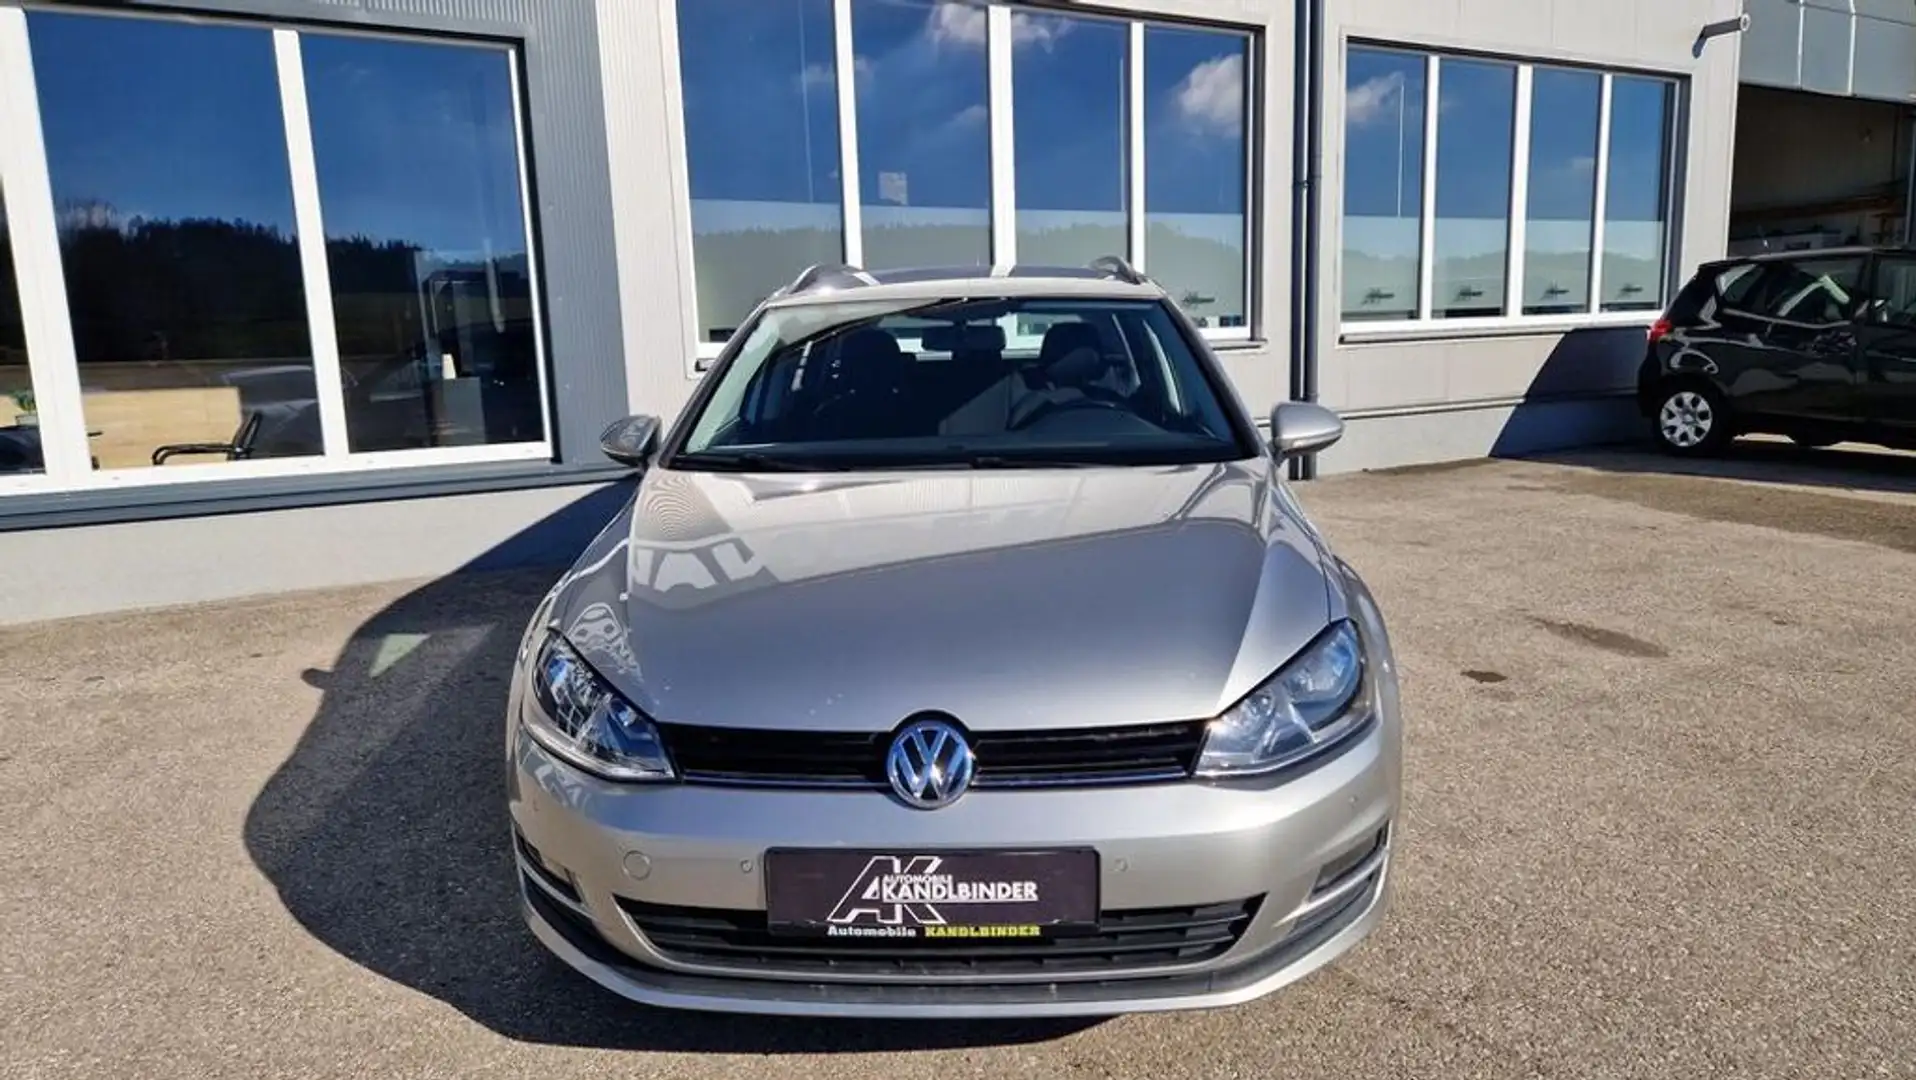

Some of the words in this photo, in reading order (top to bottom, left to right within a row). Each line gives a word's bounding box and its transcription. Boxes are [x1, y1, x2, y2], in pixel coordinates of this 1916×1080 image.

[889, 723, 970, 805] VW
[882, 880, 1038, 902] KANDLBINDER
[827, 925, 917, 937] Automobile
[924, 926, 1041, 937] KANDLBINDER
